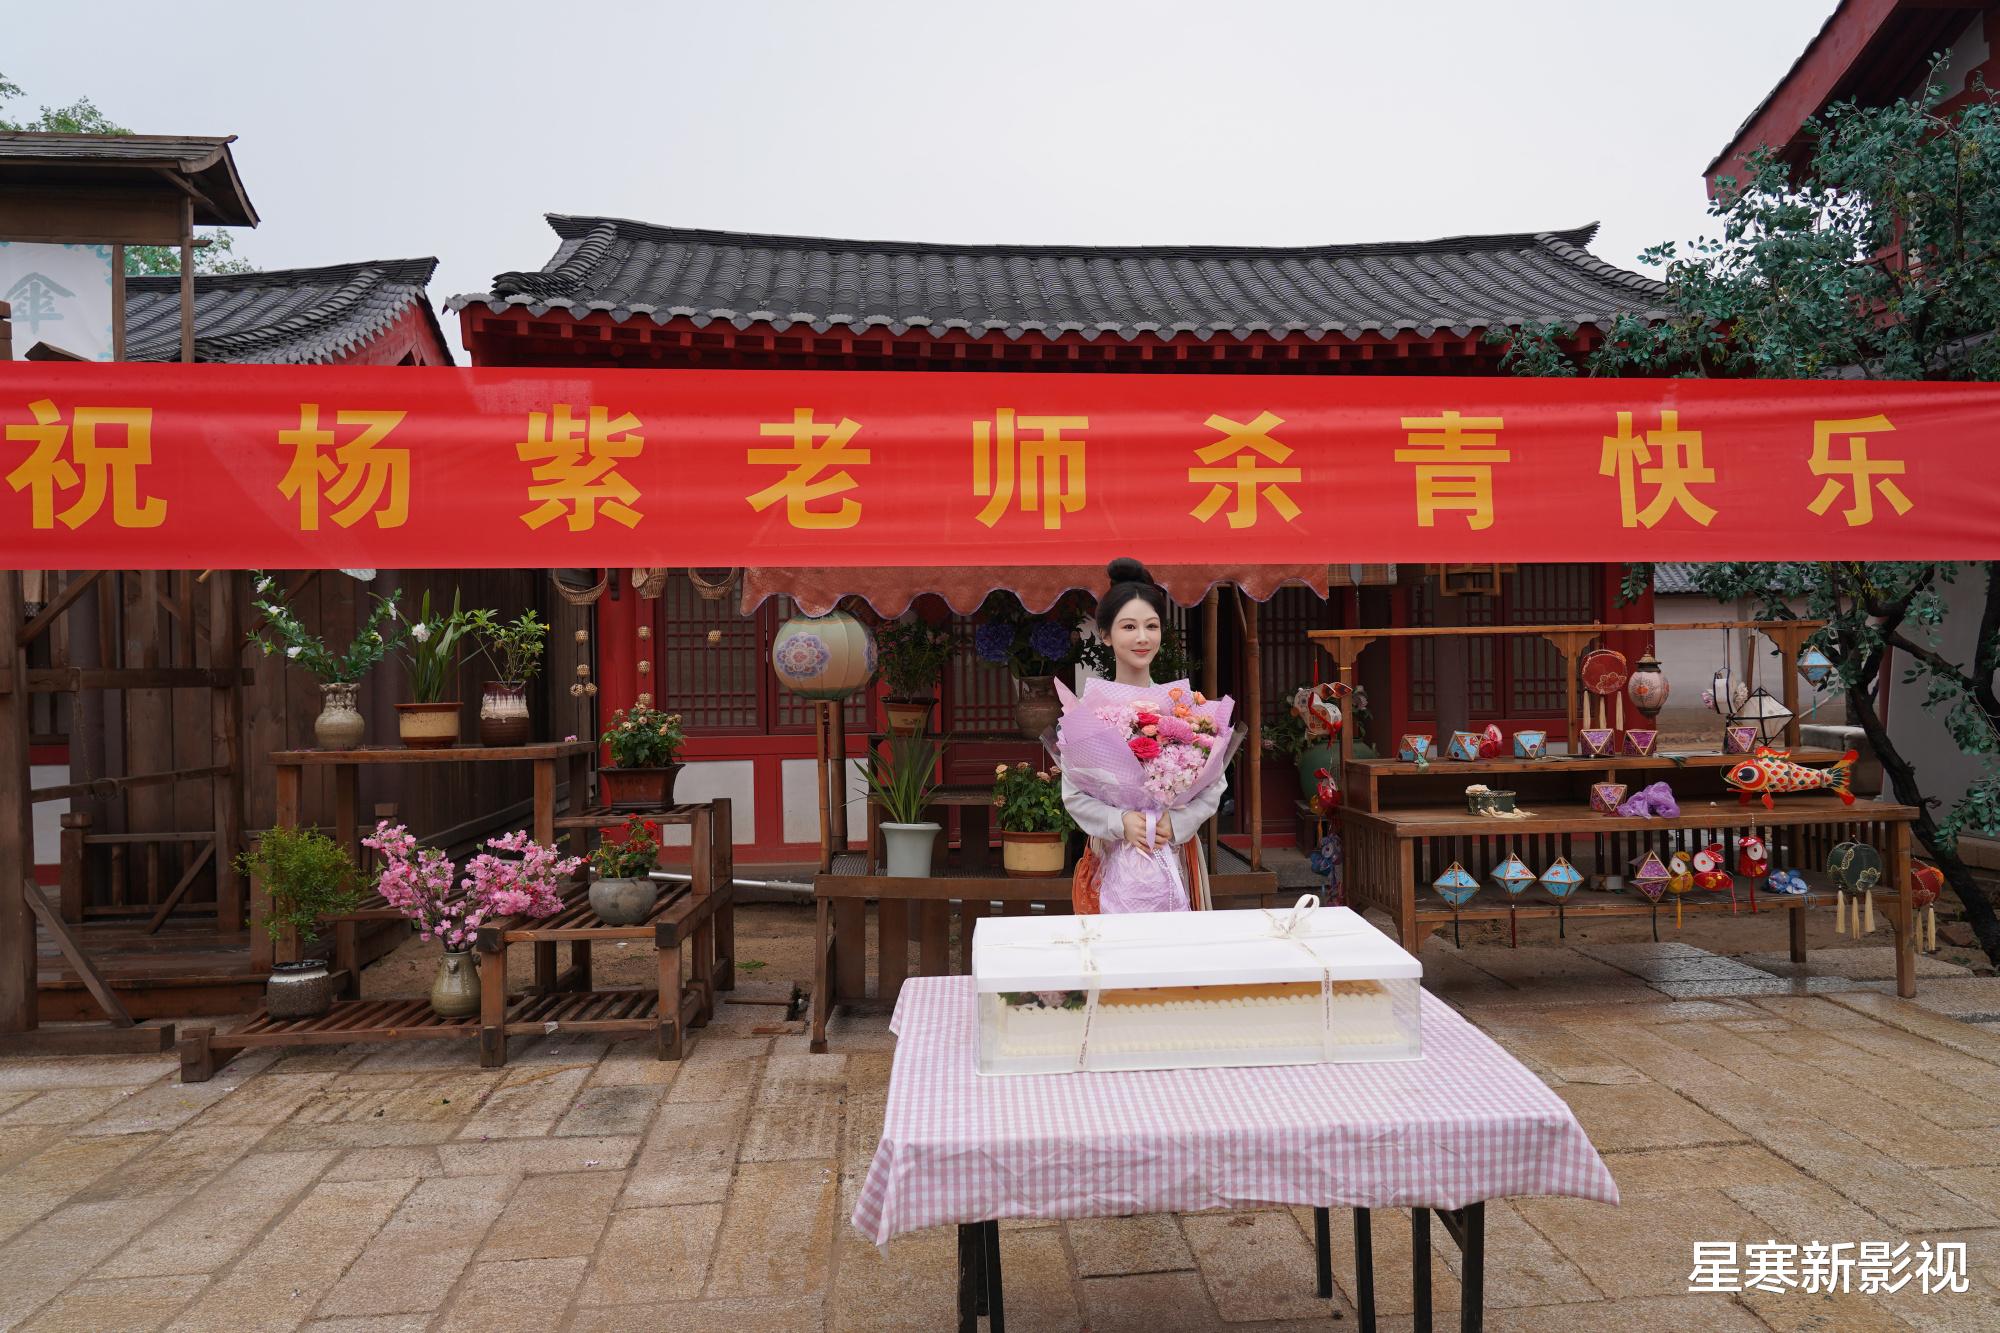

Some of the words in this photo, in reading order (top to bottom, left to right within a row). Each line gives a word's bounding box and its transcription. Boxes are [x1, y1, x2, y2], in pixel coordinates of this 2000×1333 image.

[5, 400, 1914, 531] 祝杨紫老师杀青快乐
